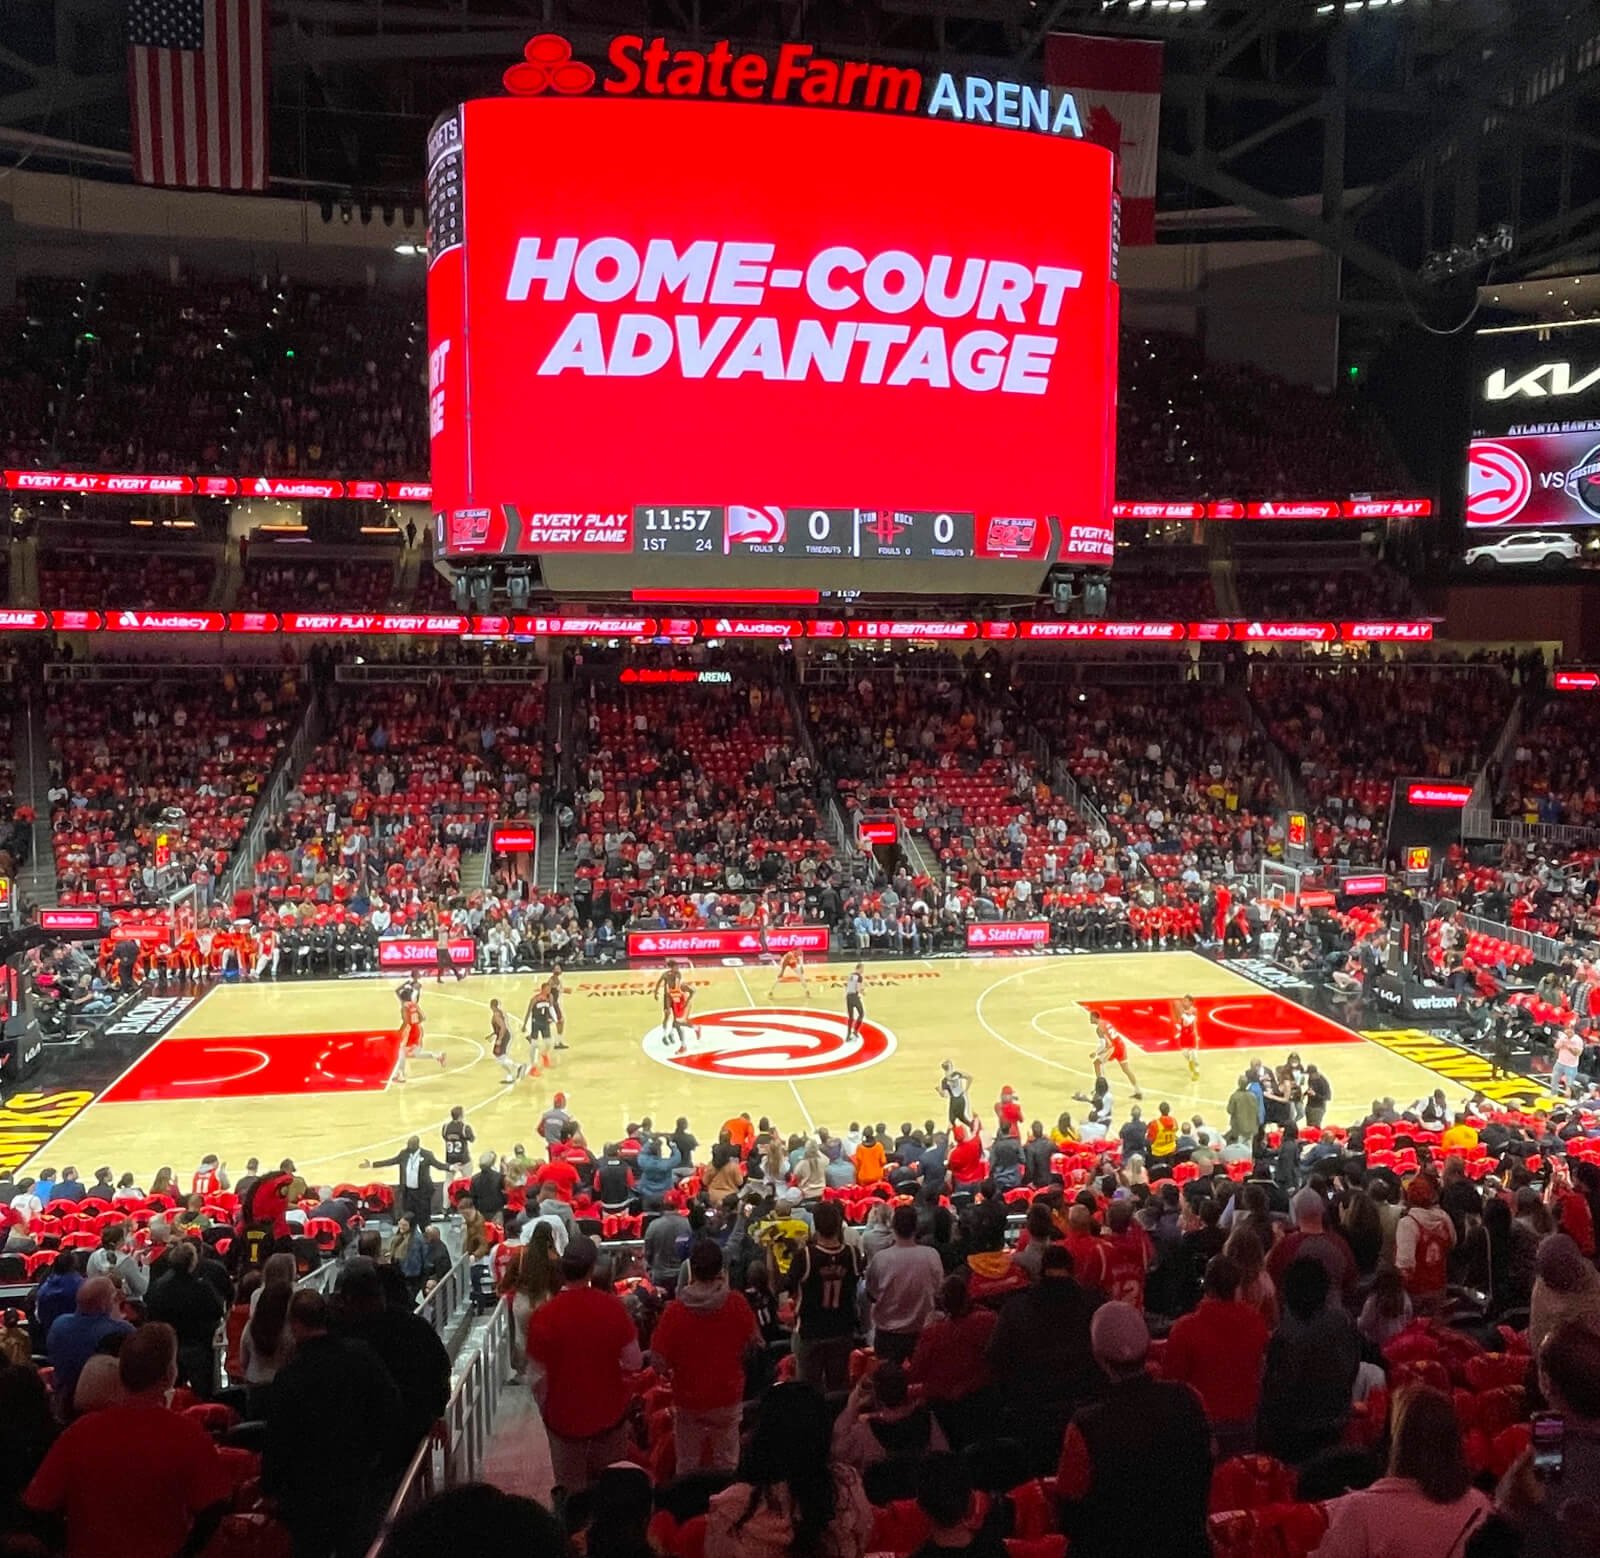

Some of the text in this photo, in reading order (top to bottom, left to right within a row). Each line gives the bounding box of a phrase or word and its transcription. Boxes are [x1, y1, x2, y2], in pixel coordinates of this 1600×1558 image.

[928, 73, 1084, 138] ARENA
[506, 236, 1083, 327] HOME-COURT
[535, 312, 1058, 395] ADVANTAGE
[1508, 425, 1560, 436] ATLANTA
[18, 475, 184, 492] EVERY PLAY EVERY GAME
[1540, 472, 1564, 489] VS
[275, 484, 333, 498] Audacy
[1132, 505, 1163, 516] EVERY
[1277, 506, 1330, 518] Audacy
[1353, 503, 1423, 515] EVERY PLAY
[532, 514, 628, 528] EVERY PLAY
[644, 509, 711, 531] 11:57
[808, 511, 830, 540] 0
[934, 514, 954, 543] 0
[1071, 526, 1102, 539] EVERY
[530, 529, 628, 543] EVERY GAME
[643, 538, 713, 551] 1ST 24
[750, 544, 774, 553] FOULS
[805, 545, 841, 554] TIMEOUTS
[878, 547, 900, 556] FOULS
[1068, 540, 1102, 554] EVERY
[143, 616, 209, 630] Audacy
[296, 616, 460, 630] EVERY PLAY EVERY GAME
[734, 622, 791, 636] Audacy
[1030, 623, 1175, 637] EVERY PLAY EVERY GAME
[1269, 625, 1326, 639] Audacy
[1352, 626, 1430, 637] EVERY PLAY
[698, 671, 732, 682] ARENA
[1413, 995, 1458, 1010] verizon
